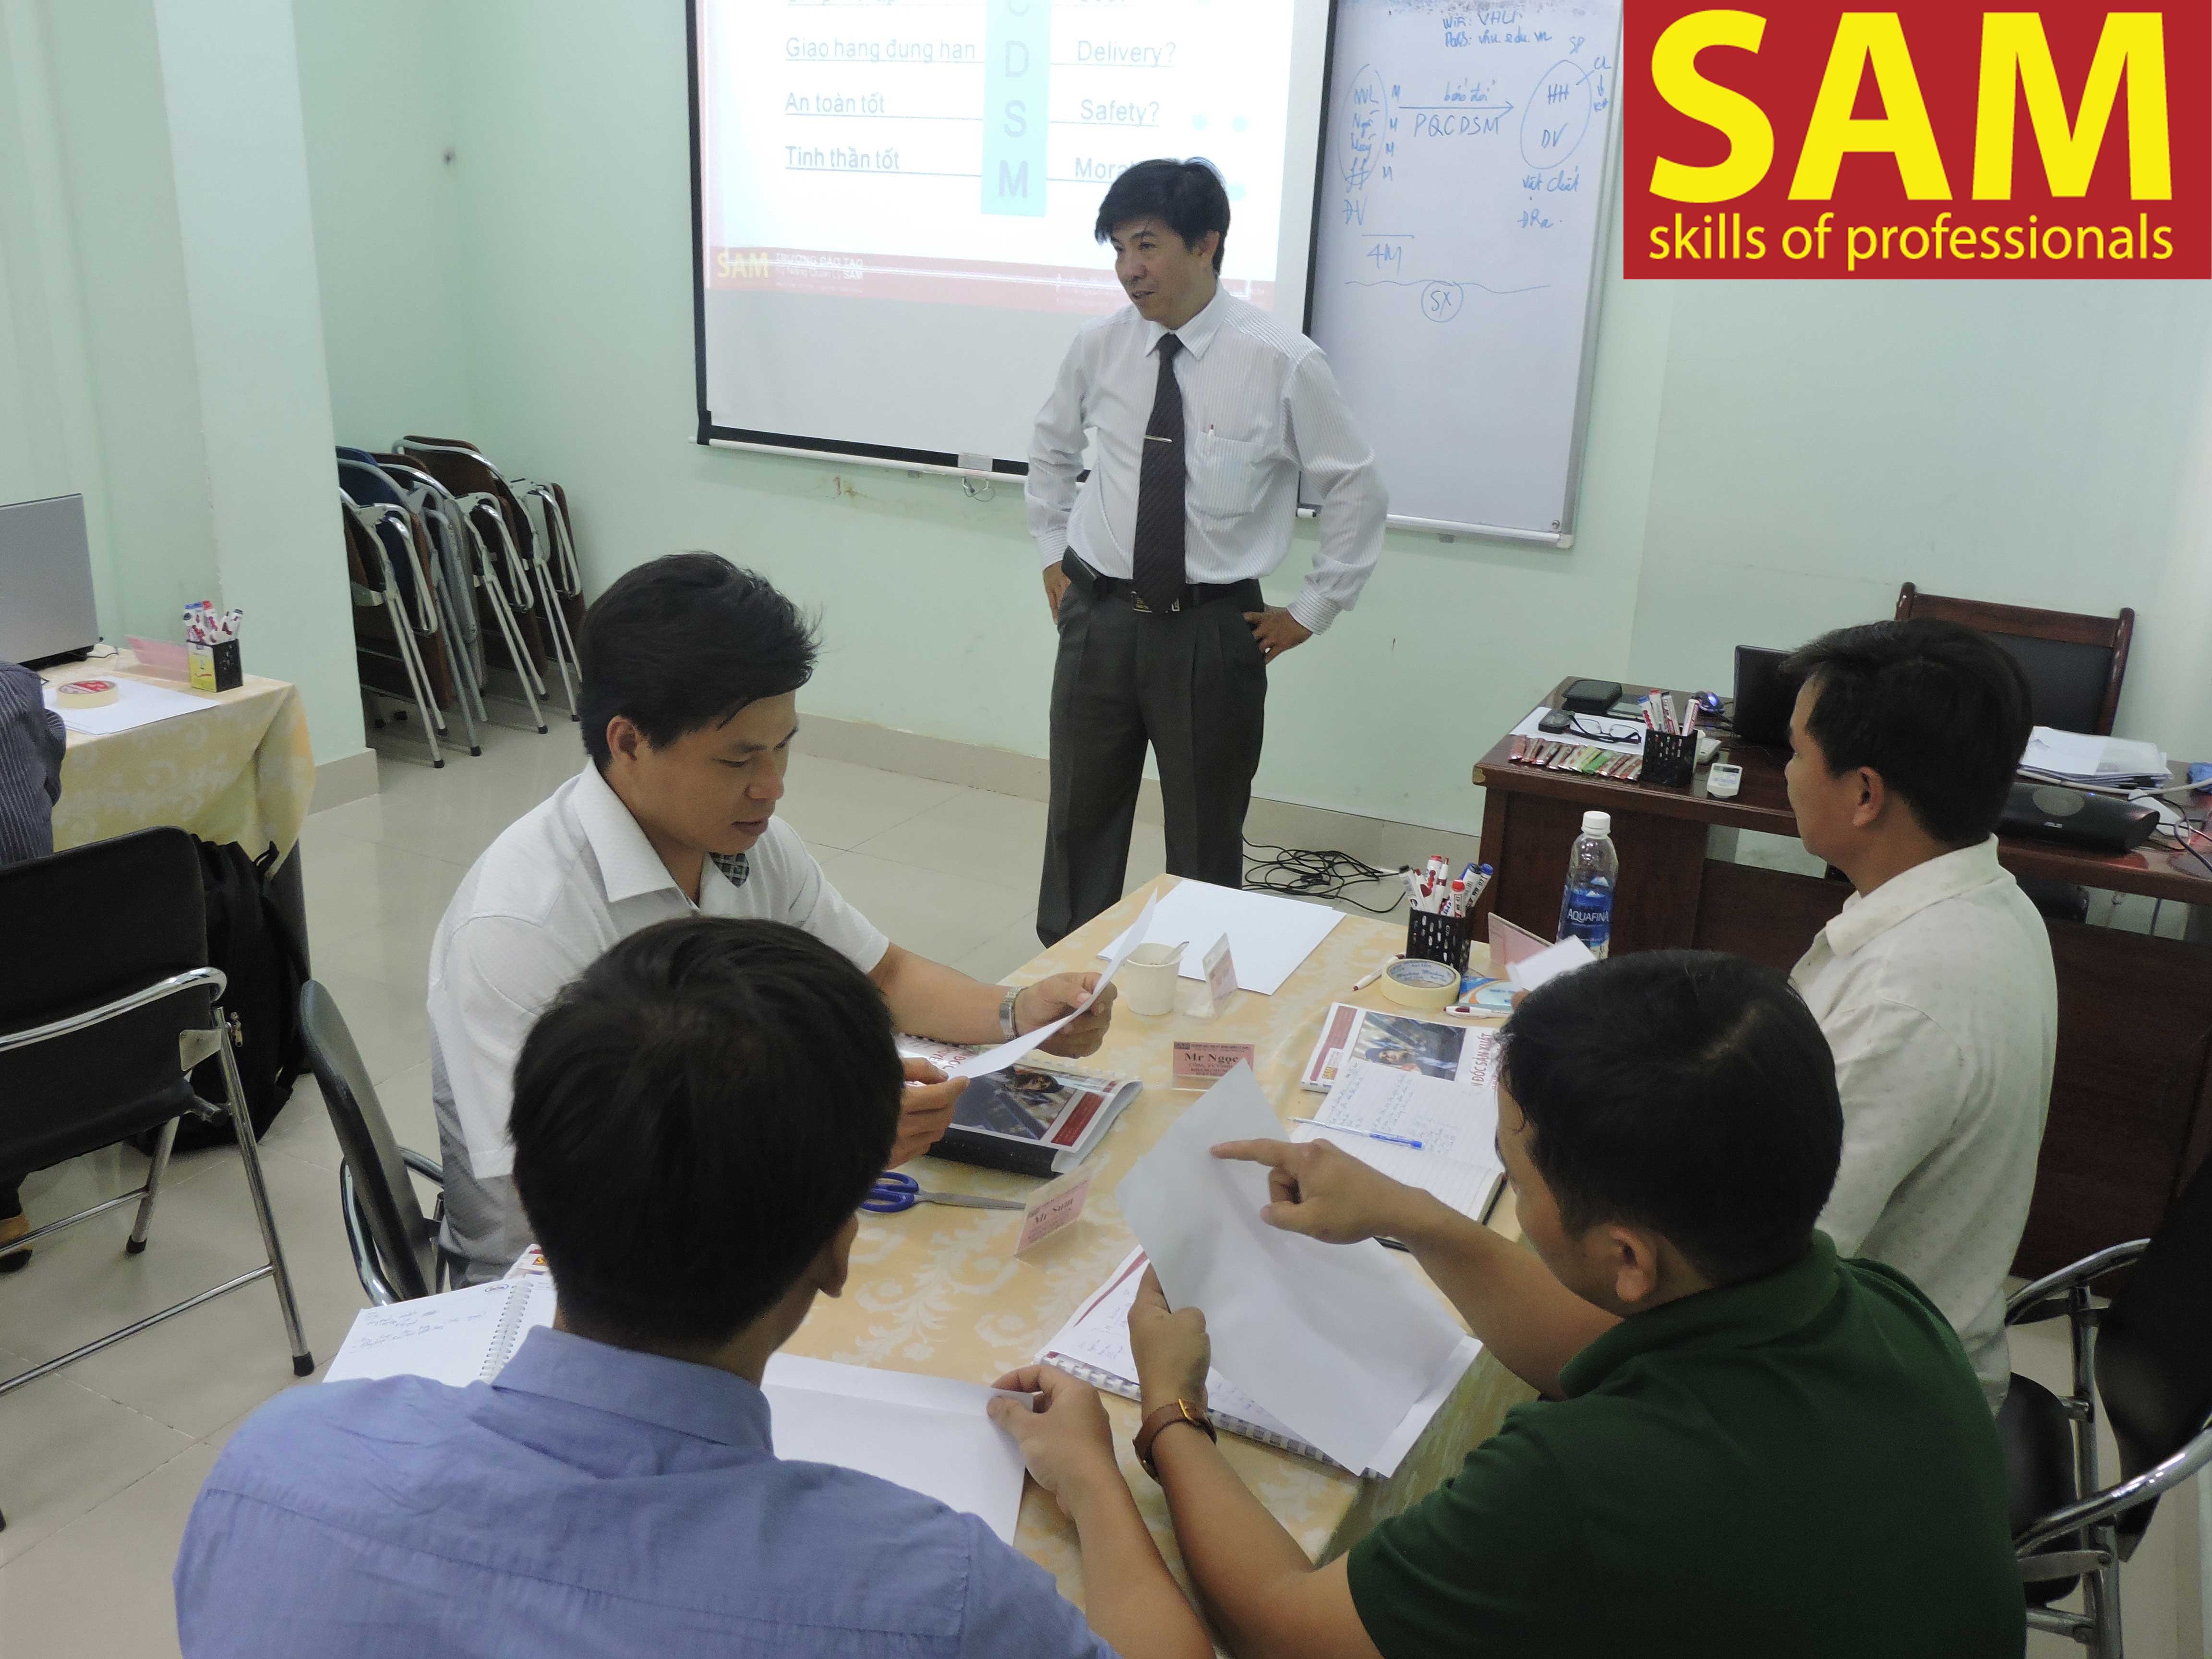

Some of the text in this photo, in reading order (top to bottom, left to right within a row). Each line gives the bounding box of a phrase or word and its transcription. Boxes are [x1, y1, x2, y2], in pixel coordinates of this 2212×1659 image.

[785, 36, 830, 58] Giao
[1004, 40, 1030, 78] D
[1077, 40, 1177, 67] Delivery?
[785, 92, 810, 111] An
[815, 92, 856, 113] toàn
[1080, 99, 1160, 127] Safety?
[1003, 99, 1027, 138] S
[998, 158, 1029, 199] M
[1075, 157, 1134, 180] Mora
[1567, 908, 1609, 922] AQUAFINA
